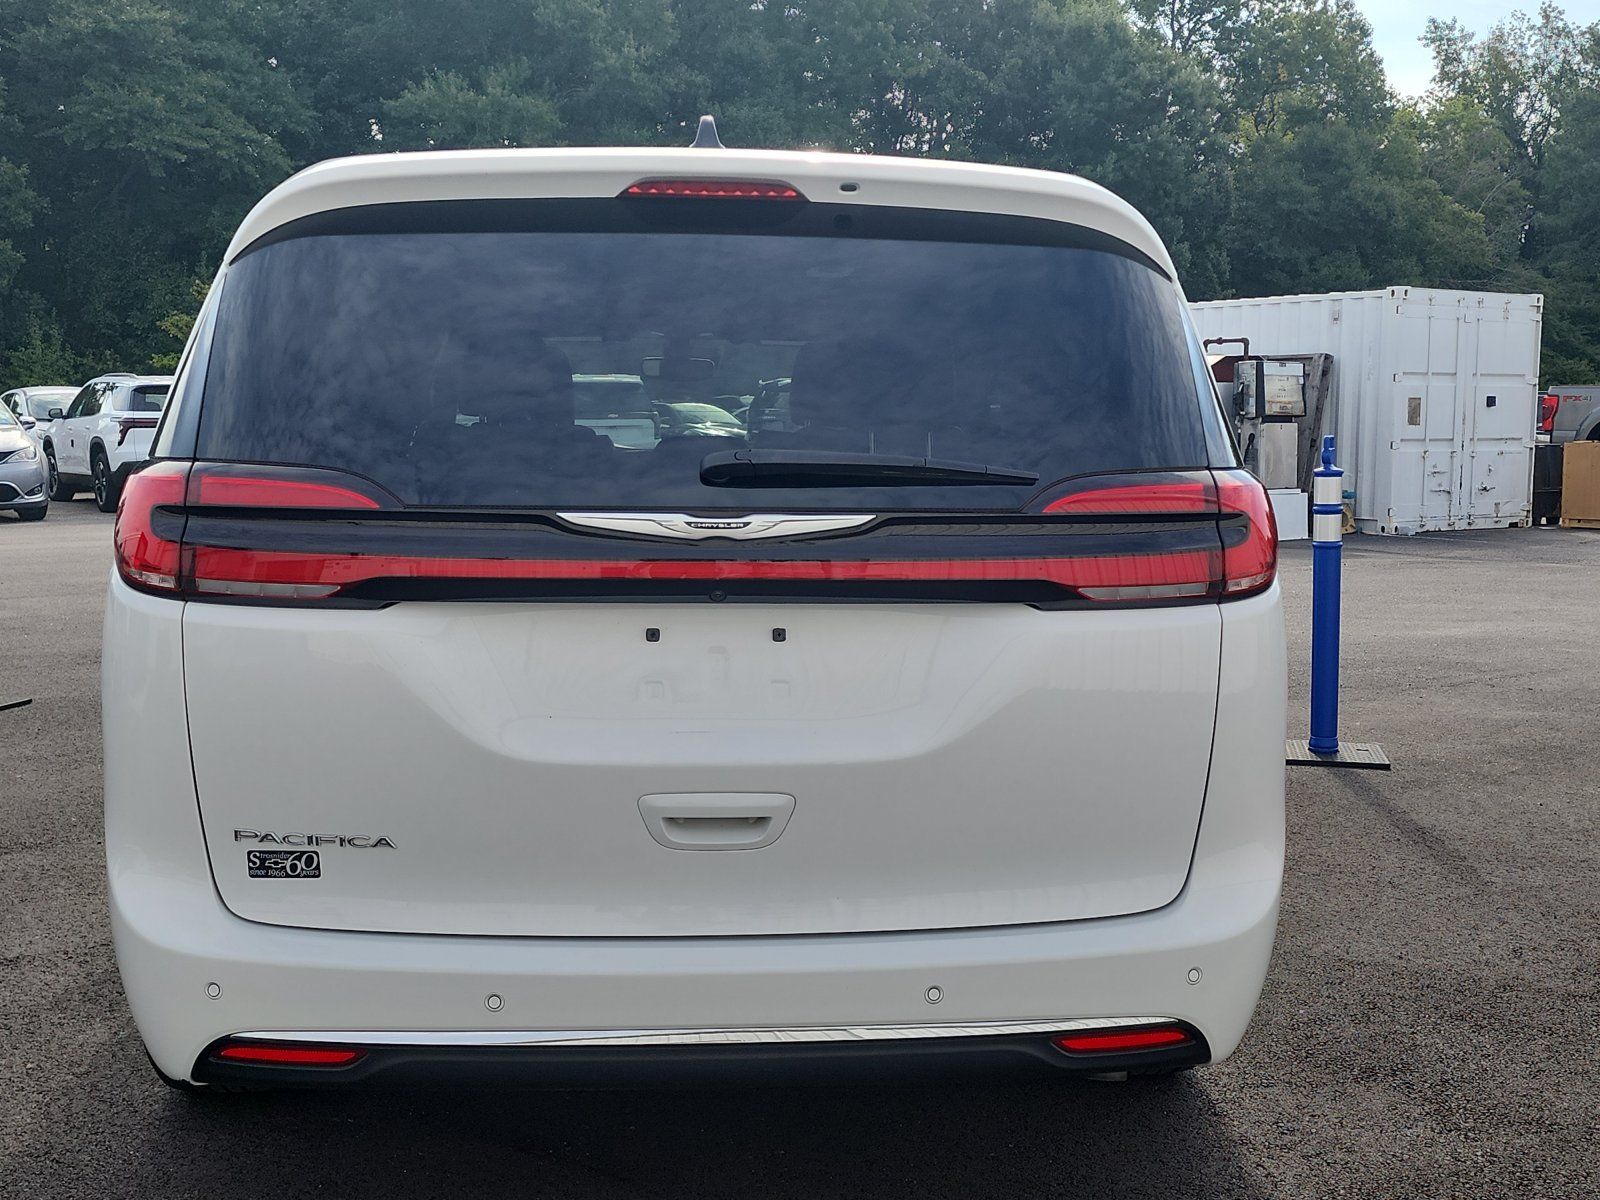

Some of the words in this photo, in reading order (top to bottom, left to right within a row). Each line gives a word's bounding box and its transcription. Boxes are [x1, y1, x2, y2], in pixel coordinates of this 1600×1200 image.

[233, 828, 397, 849] PACIFICA
[250, 868, 266, 876] since
[268, 869, 286, 877] 1966
[286, 852, 318, 875] 60
